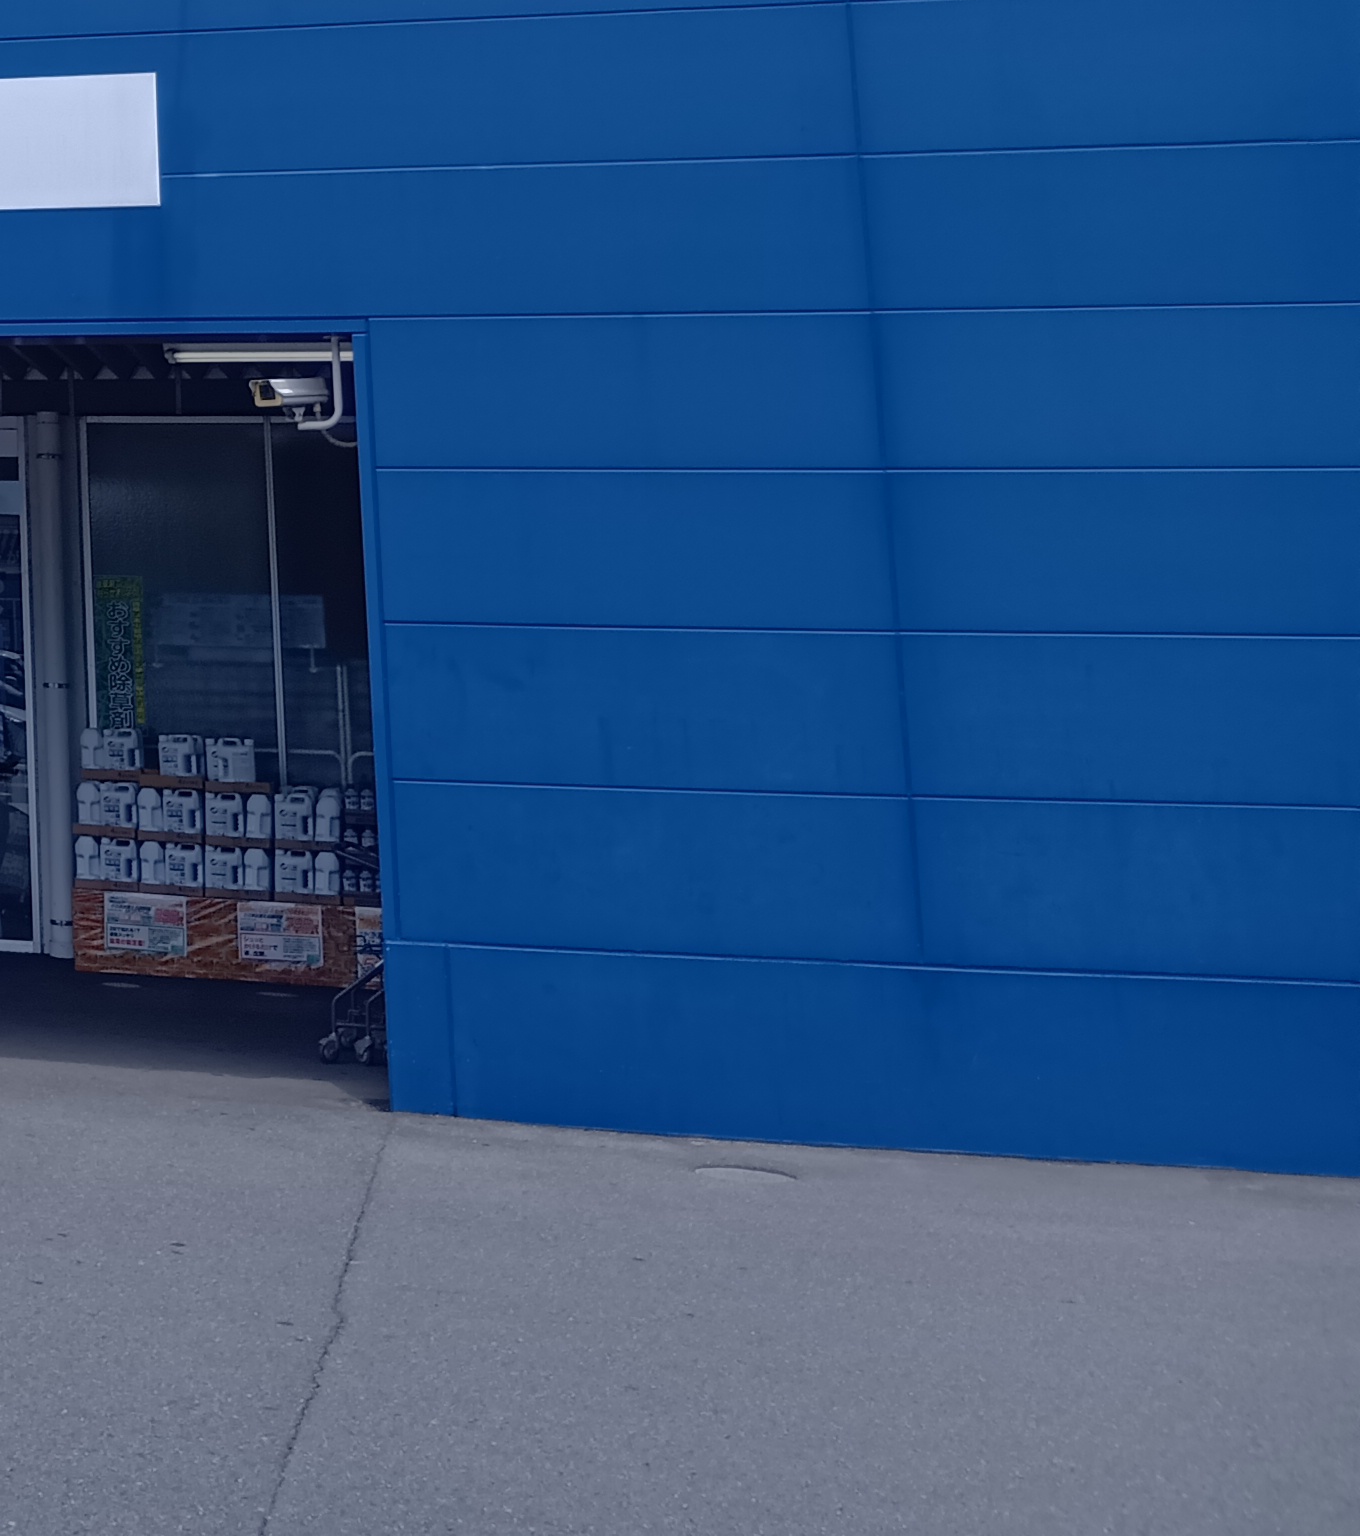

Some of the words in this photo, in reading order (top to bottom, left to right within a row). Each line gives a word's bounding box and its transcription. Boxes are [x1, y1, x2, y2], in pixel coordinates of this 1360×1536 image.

[106, 599, 134, 730] おすすめ除草剤
